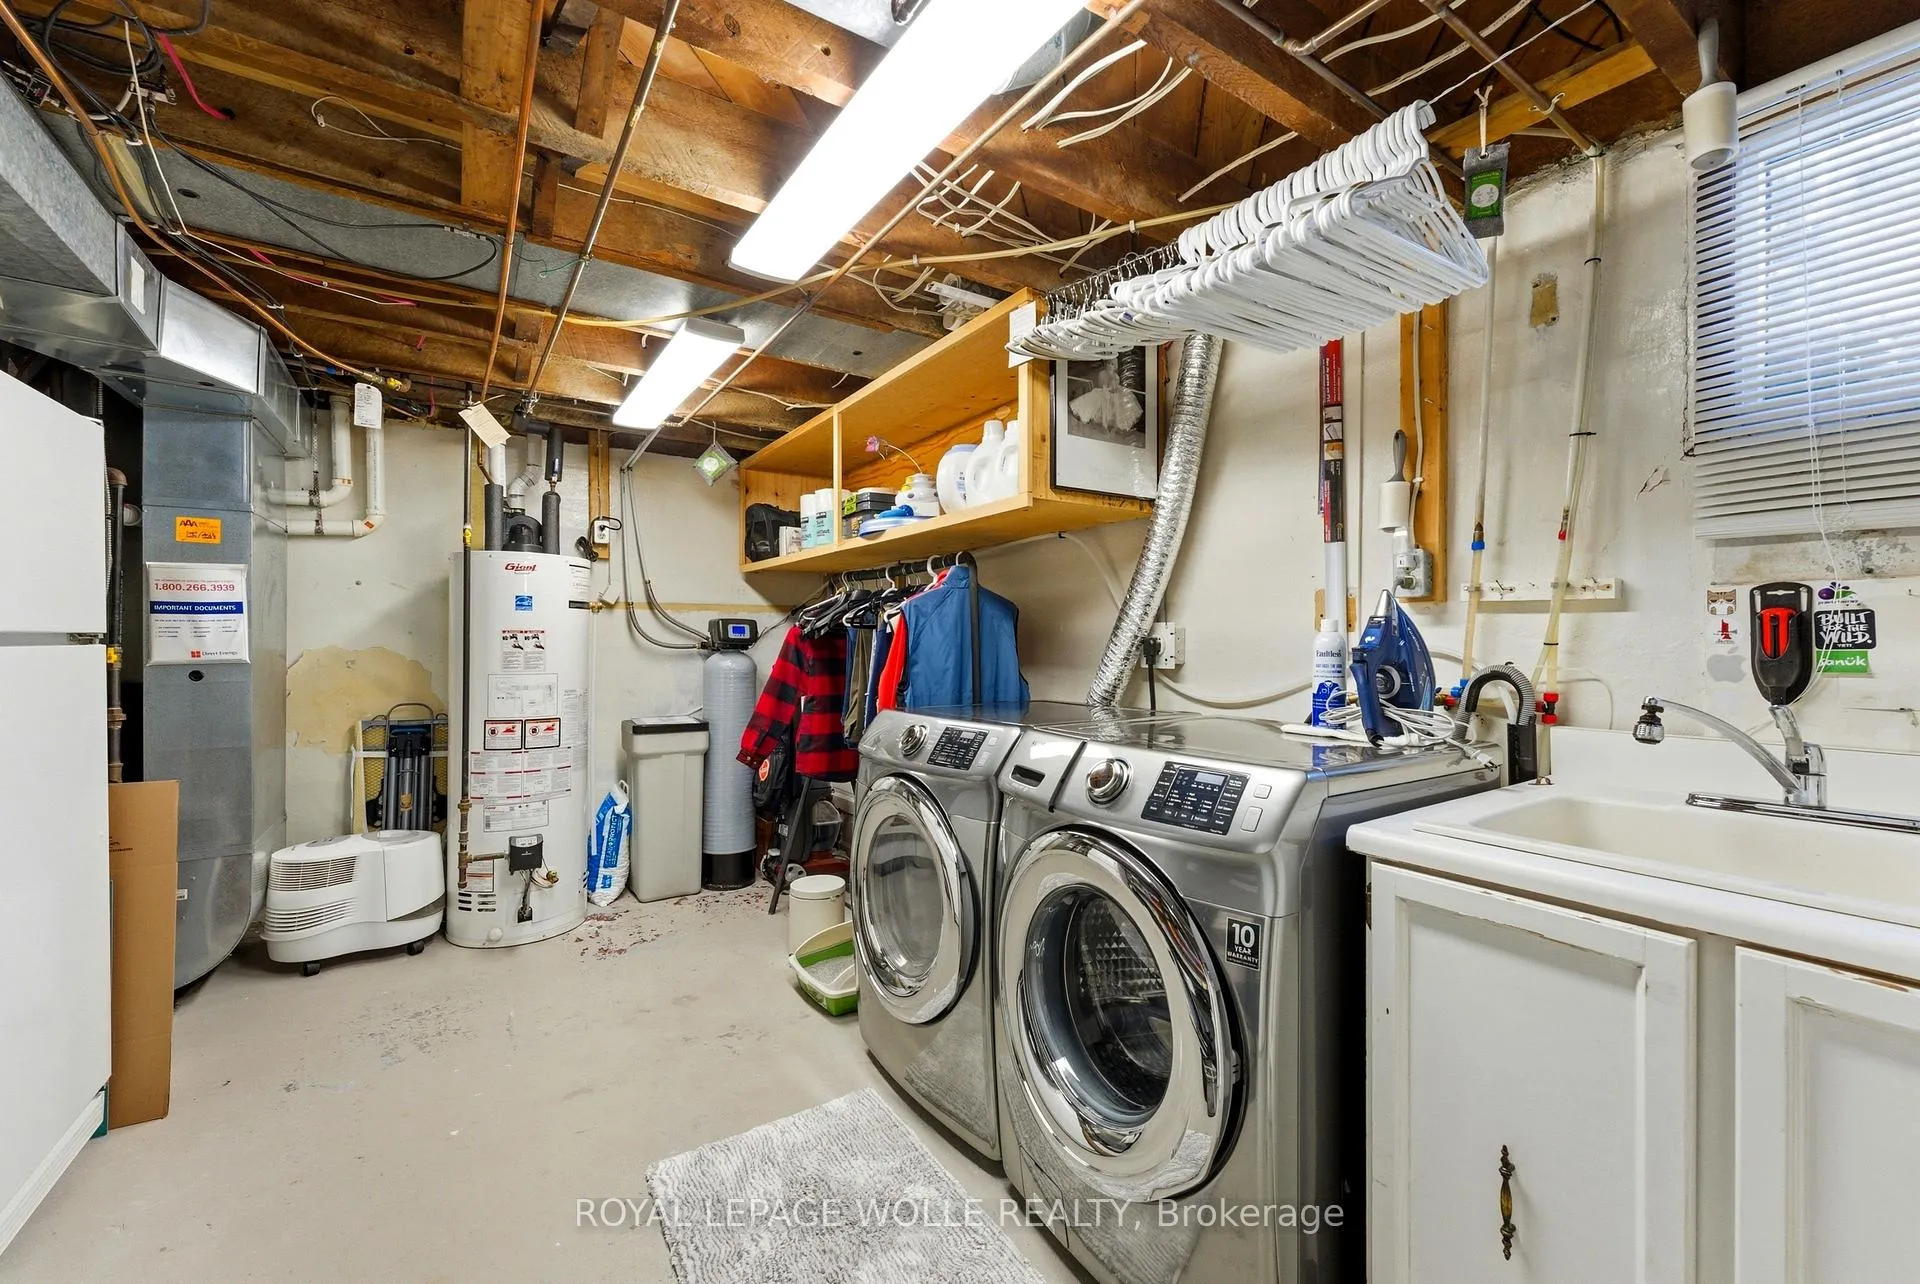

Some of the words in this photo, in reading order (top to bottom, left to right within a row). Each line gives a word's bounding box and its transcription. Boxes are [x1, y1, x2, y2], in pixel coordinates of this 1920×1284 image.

[504, 563, 537, 571] Giant
[154, 583, 235, 592] 1.800.266.3939
[1817, 611, 1871, 625] BUILT
[1846, 624, 1869, 632] THE
[1231, 923, 1255, 947] 10
[1234, 945, 1252, 955] YEAR
[1227, 951, 1259, 963] WARRANTY
